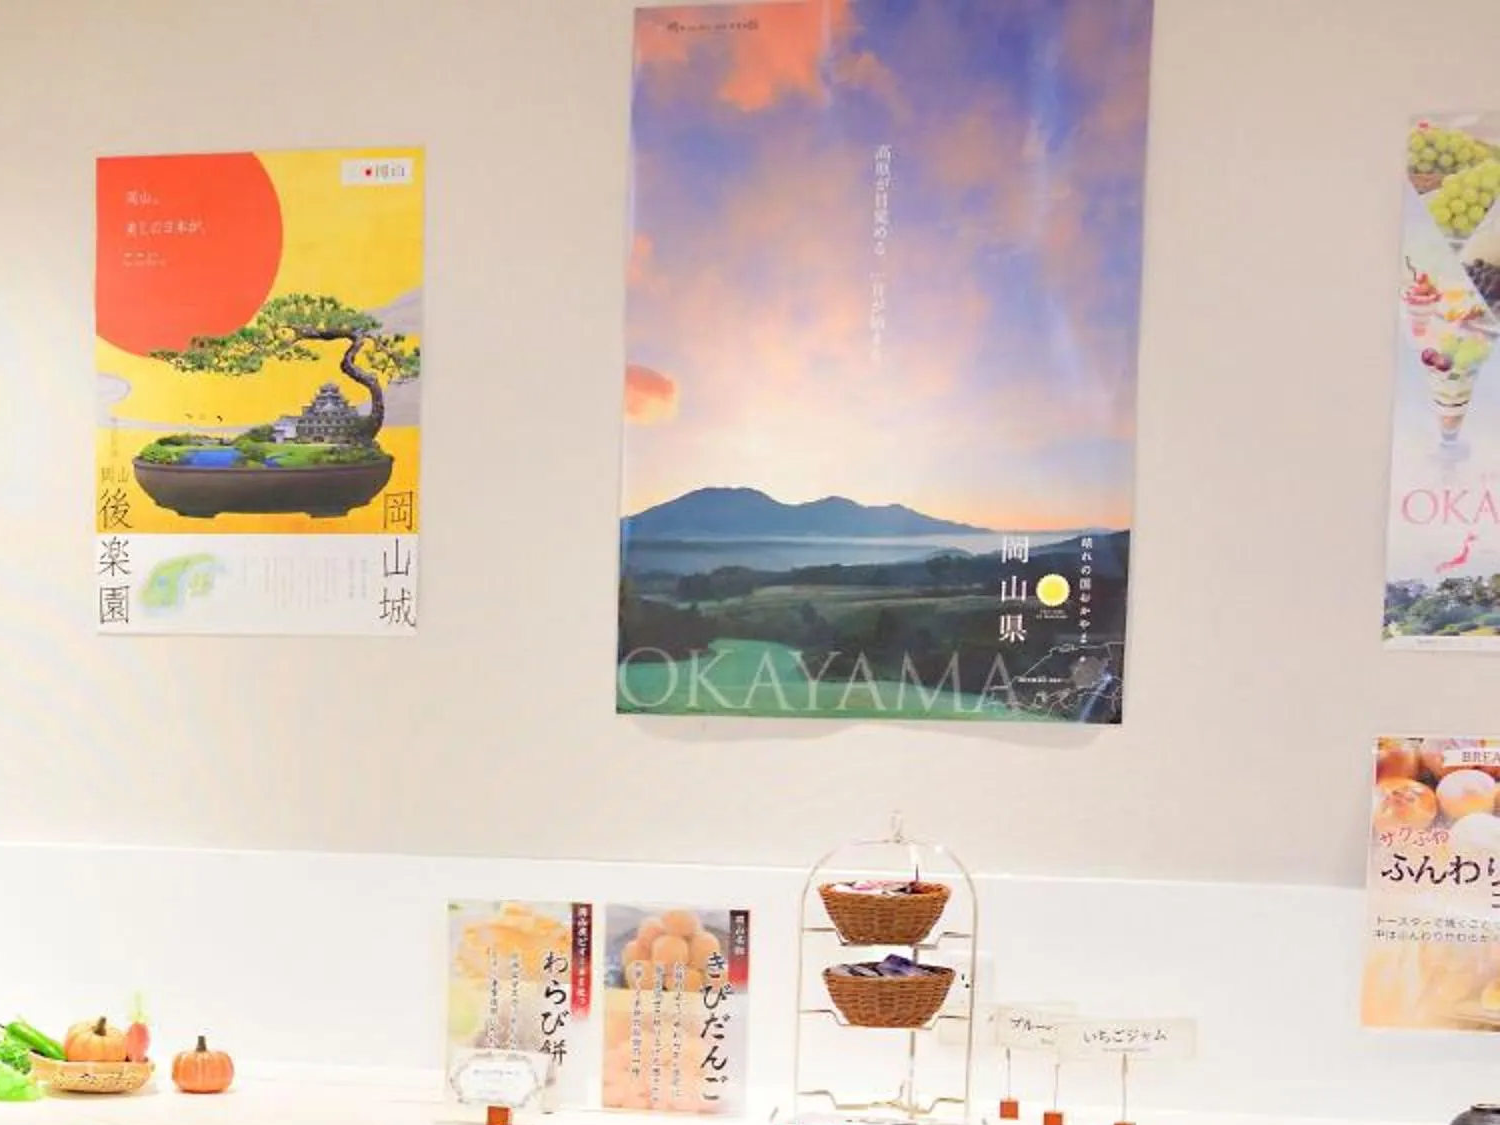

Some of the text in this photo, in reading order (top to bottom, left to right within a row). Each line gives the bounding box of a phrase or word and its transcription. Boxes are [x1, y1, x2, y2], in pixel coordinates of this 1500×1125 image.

[98, 487, 134, 626] 後楽園
[379, 489, 417, 627] 岡山城
[999, 534, 1030, 643] 岡山県
[619, 646, 1024, 713] OKAYAMA
[540, 951, 570, 1065] わらび餅
[700, 951, 733, 1101] きびだんご
[1084, 1029, 1168, 1043] いちごジャム
